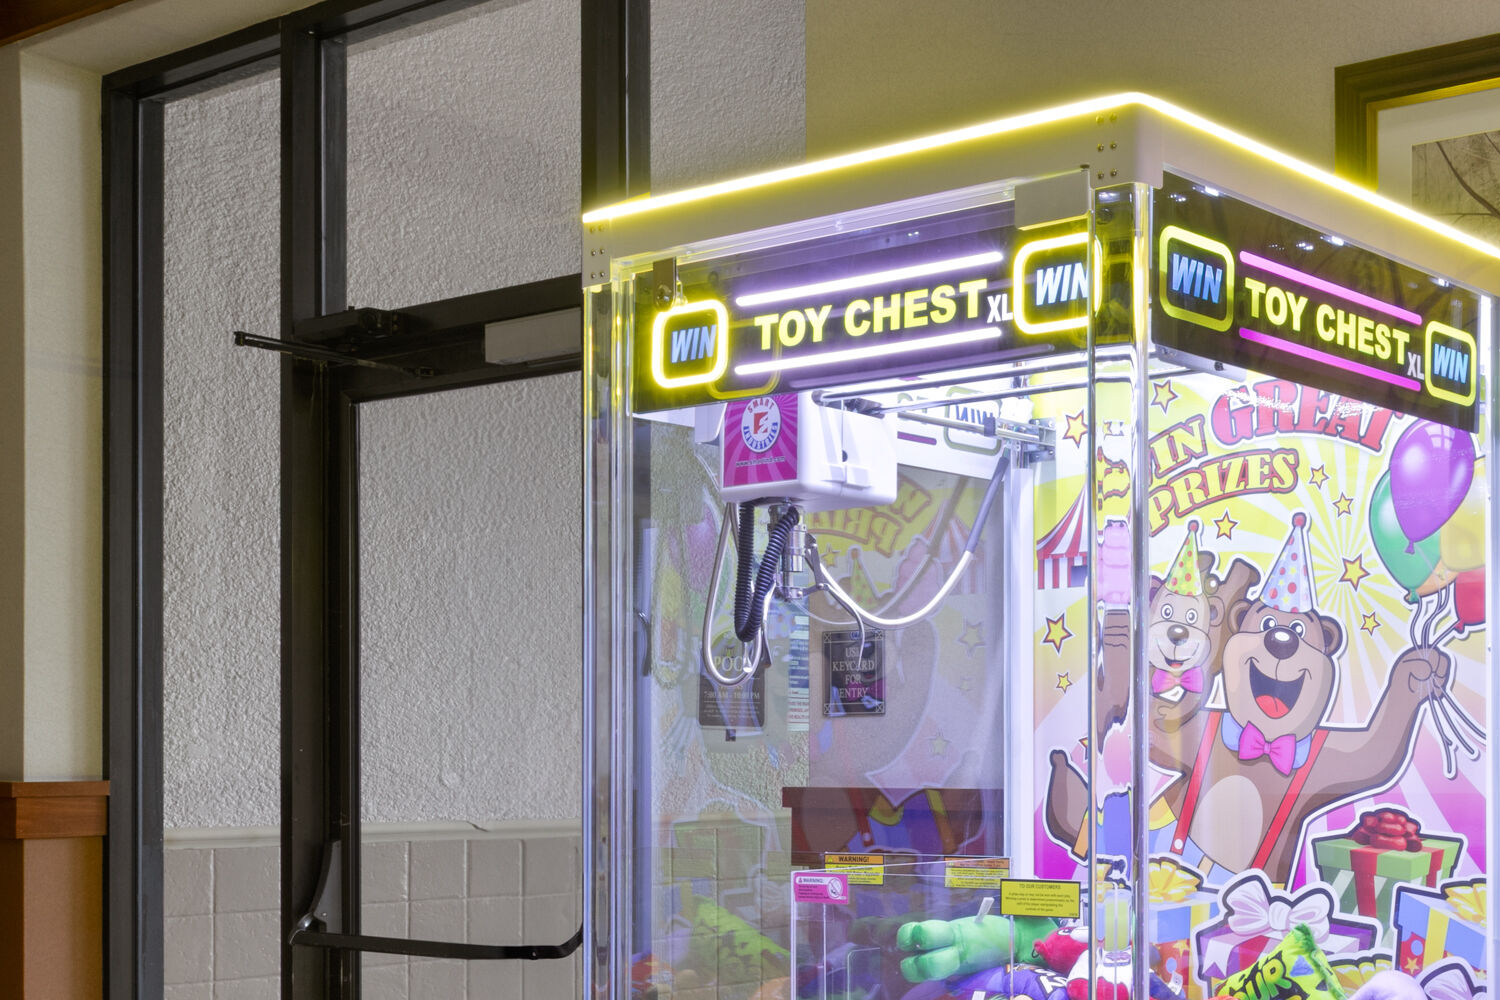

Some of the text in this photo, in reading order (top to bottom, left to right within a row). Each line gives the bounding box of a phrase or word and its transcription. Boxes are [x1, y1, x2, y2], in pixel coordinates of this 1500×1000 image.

[1036, 262, 1089, 306] WIN
[1171, 253, 1222, 304] WIN
[754, 278, 1014, 351] TOY CHEST XL
[1245, 277, 1425, 381] TOY CHEST XL
[671, 324, 717, 364] WIN
[1433, 343, 1468, 384] WIN
[1149, 415, 1207, 479] IN
[1149, 449, 1298, 537] PRIZES
[839, 687, 869, 698] ENTRY
[844, 675, 862, 684] FOR
[838, 855, 869, 863] WARNING!
